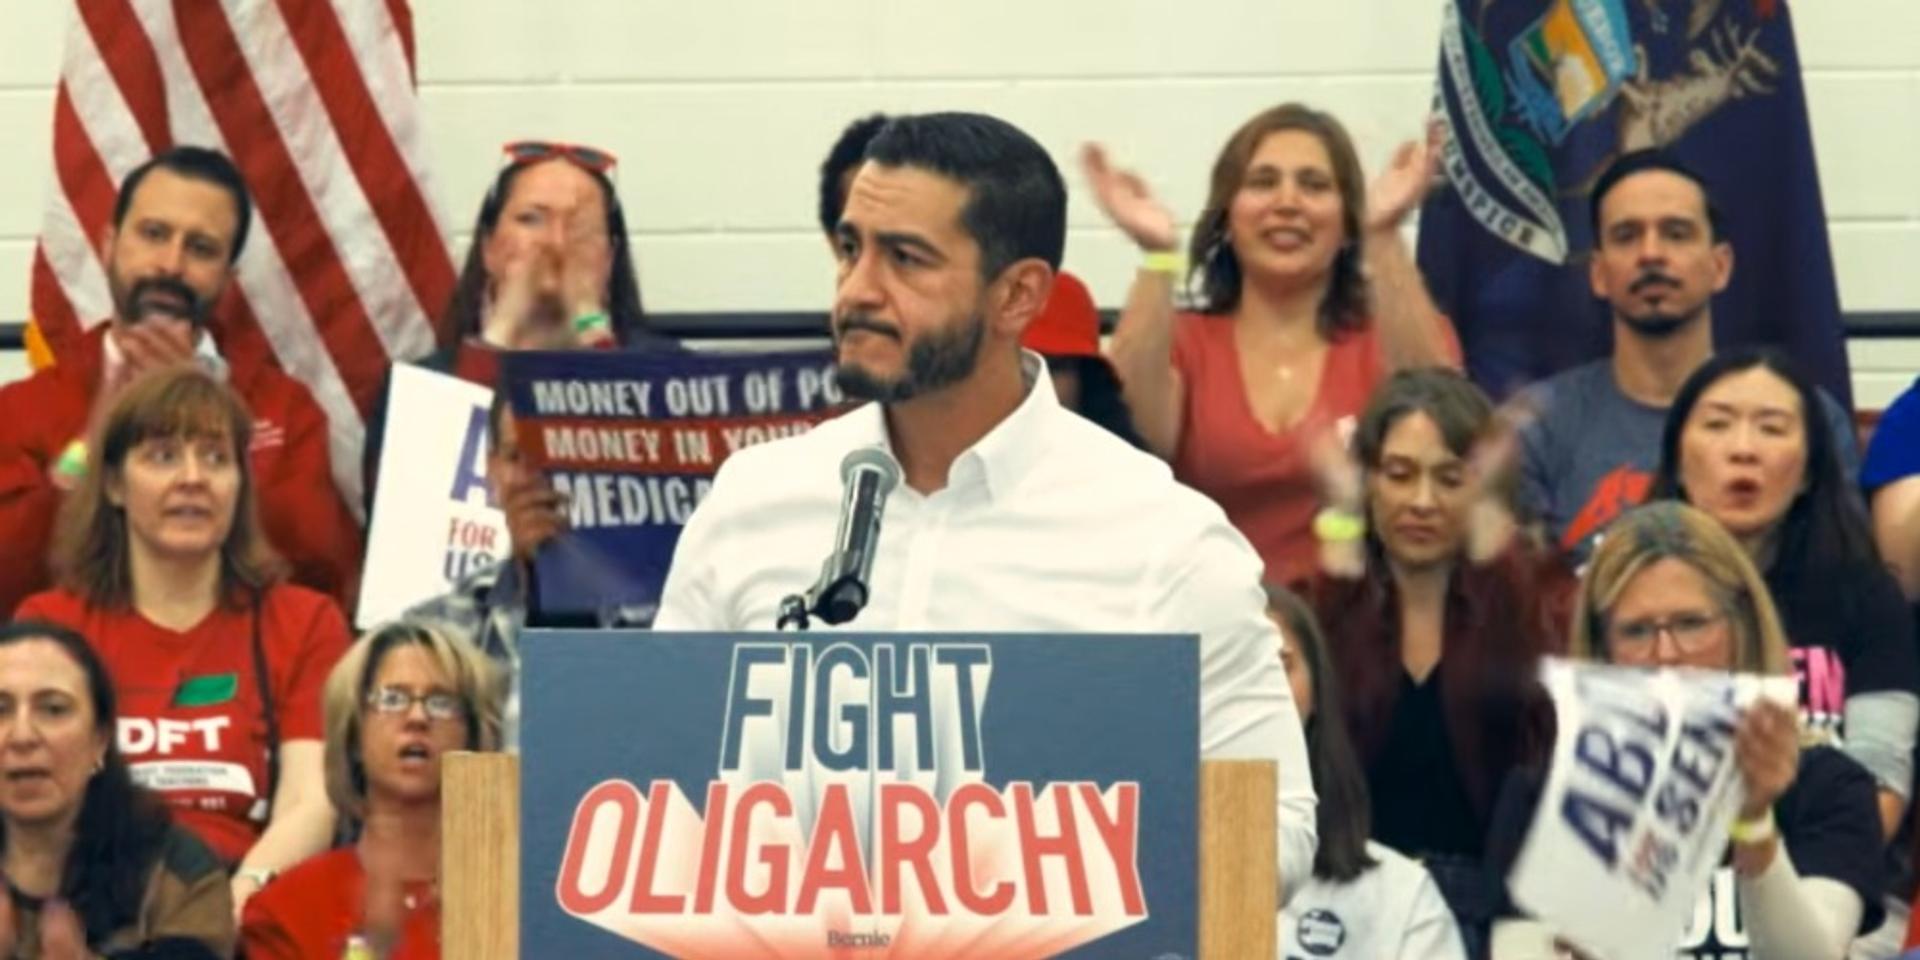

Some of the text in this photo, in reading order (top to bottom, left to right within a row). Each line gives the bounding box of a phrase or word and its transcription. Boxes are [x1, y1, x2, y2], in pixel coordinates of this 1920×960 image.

[532, 379, 651, 415] MONEY
[665, 376, 730, 415] OUT
[743, 367, 784, 413] OF
[544, 427, 662, 464] MONEY
[674, 428, 712, 464] IN
[450, 517, 498, 550] FOR
[718, 642, 992, 773] FIGHT
[116, 716, 230, 754] DFT
[555, 778, 1149, 918] OLIGARCHY
[827, 928, 891, 948] Bernie
